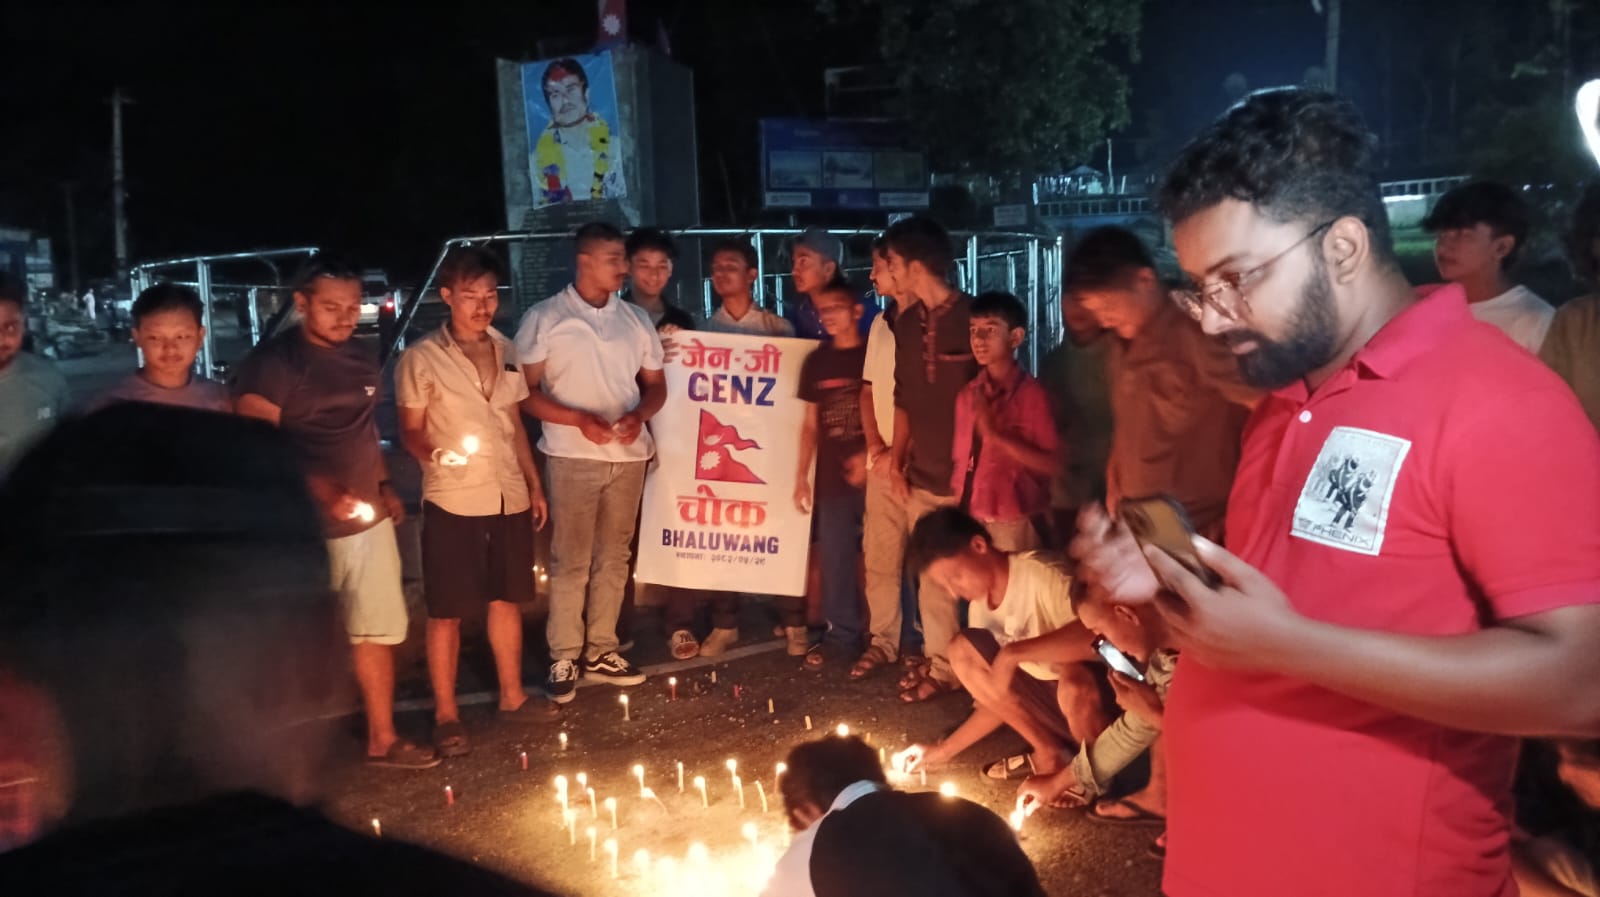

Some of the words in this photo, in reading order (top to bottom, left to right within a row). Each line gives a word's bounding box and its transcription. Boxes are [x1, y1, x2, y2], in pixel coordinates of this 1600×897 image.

[688, 372, 776, 406] GENZ
[676, 484, 768, 528] चोक
[662, 528, 779, 554] BHALUWANG
